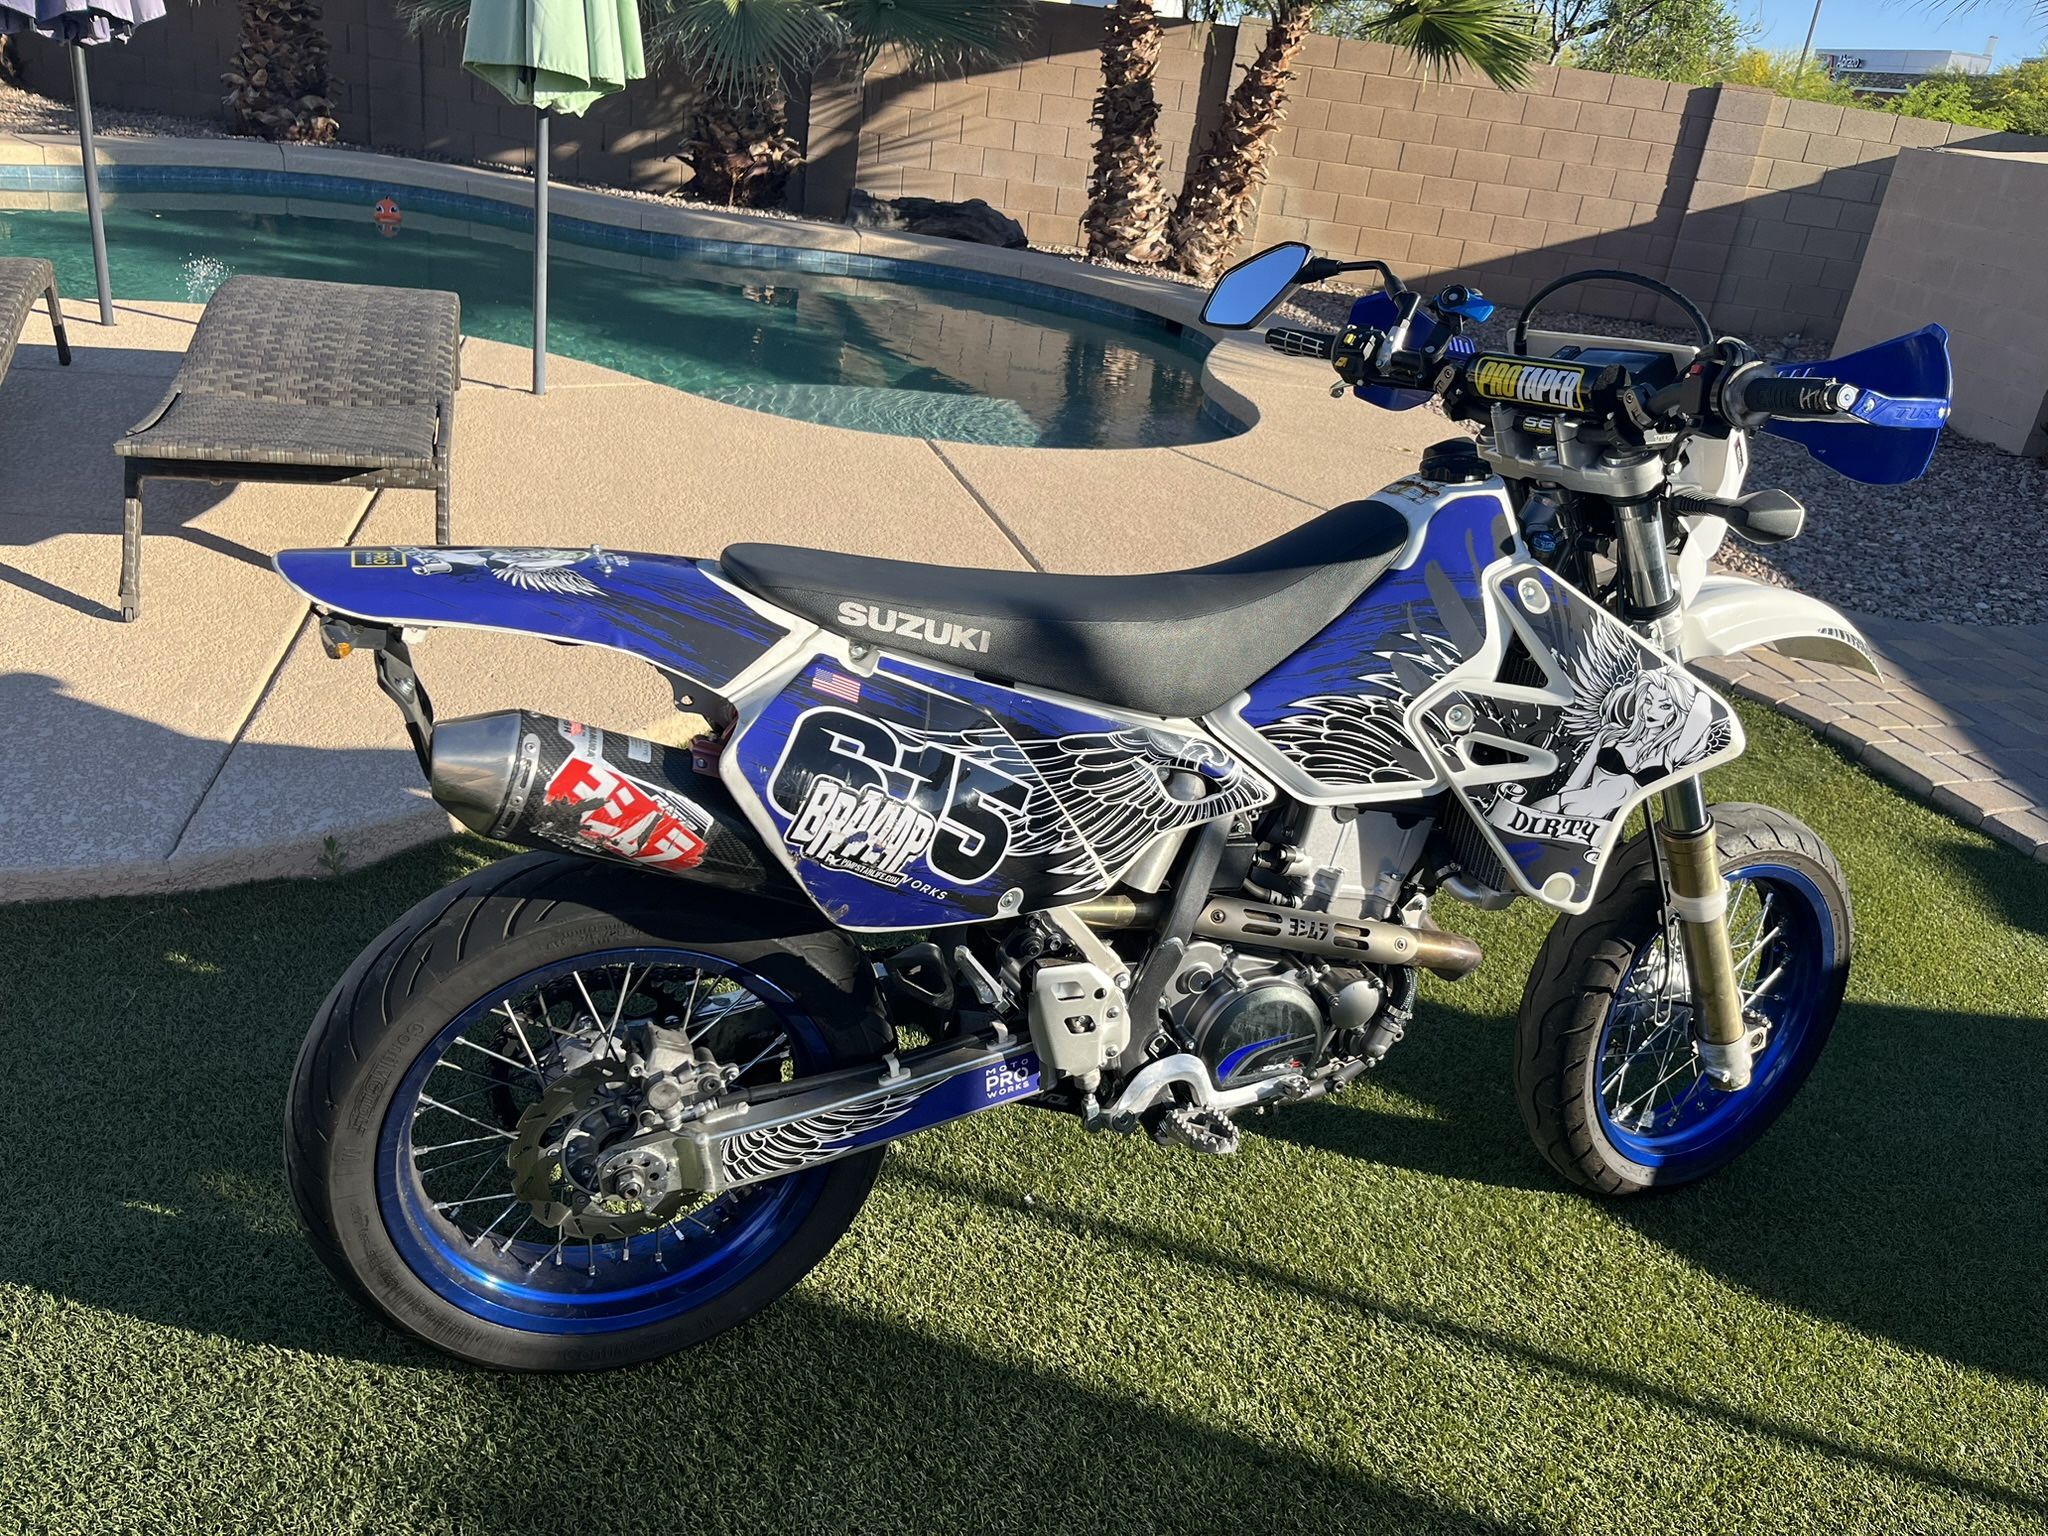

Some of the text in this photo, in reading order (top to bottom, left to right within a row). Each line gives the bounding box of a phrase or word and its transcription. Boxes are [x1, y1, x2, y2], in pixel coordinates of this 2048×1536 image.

[837, 601, 991, 653] SUZUKI
[1507, 807, 1600, 845] DIRTY
[985, 1058, 1029, 1077] MOTO
[985, 1066, 1029, 1092] PRO
[986, 1080, 1030, 1099] WORKS
